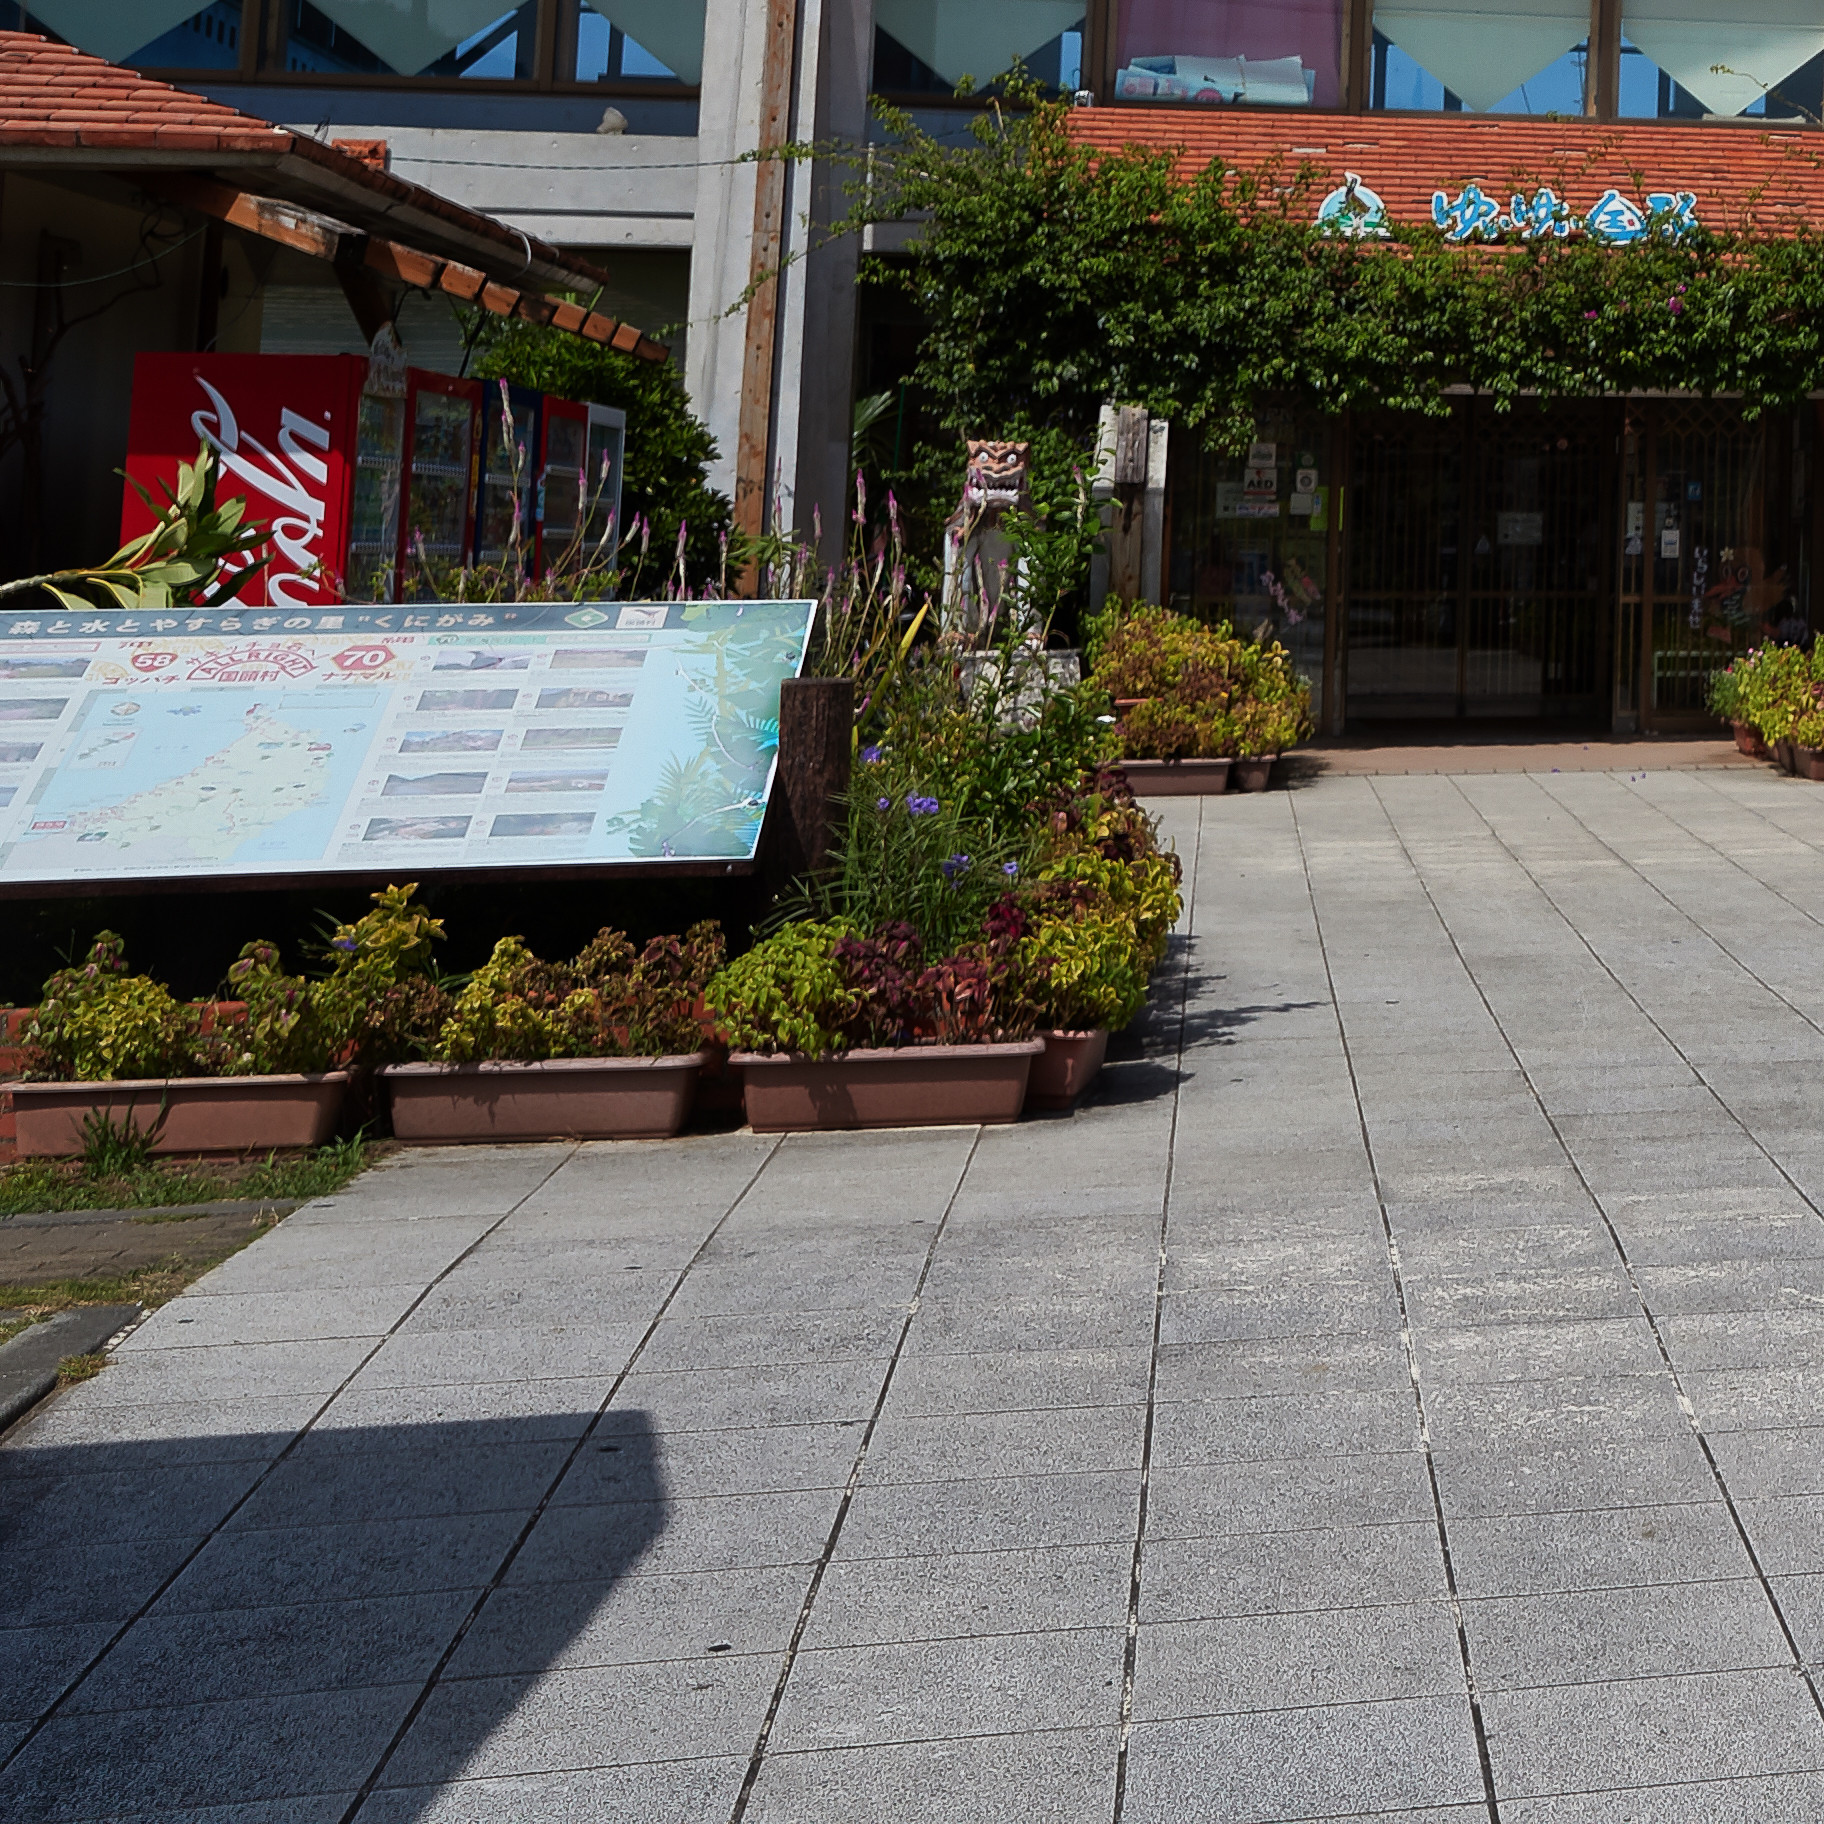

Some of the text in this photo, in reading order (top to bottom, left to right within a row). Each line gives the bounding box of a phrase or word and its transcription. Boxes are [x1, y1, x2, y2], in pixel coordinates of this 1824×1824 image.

[1246, 479, 1274, 489] AED
[135, 654, 173, 668] 58
[342, 649, 387, 668] 70
